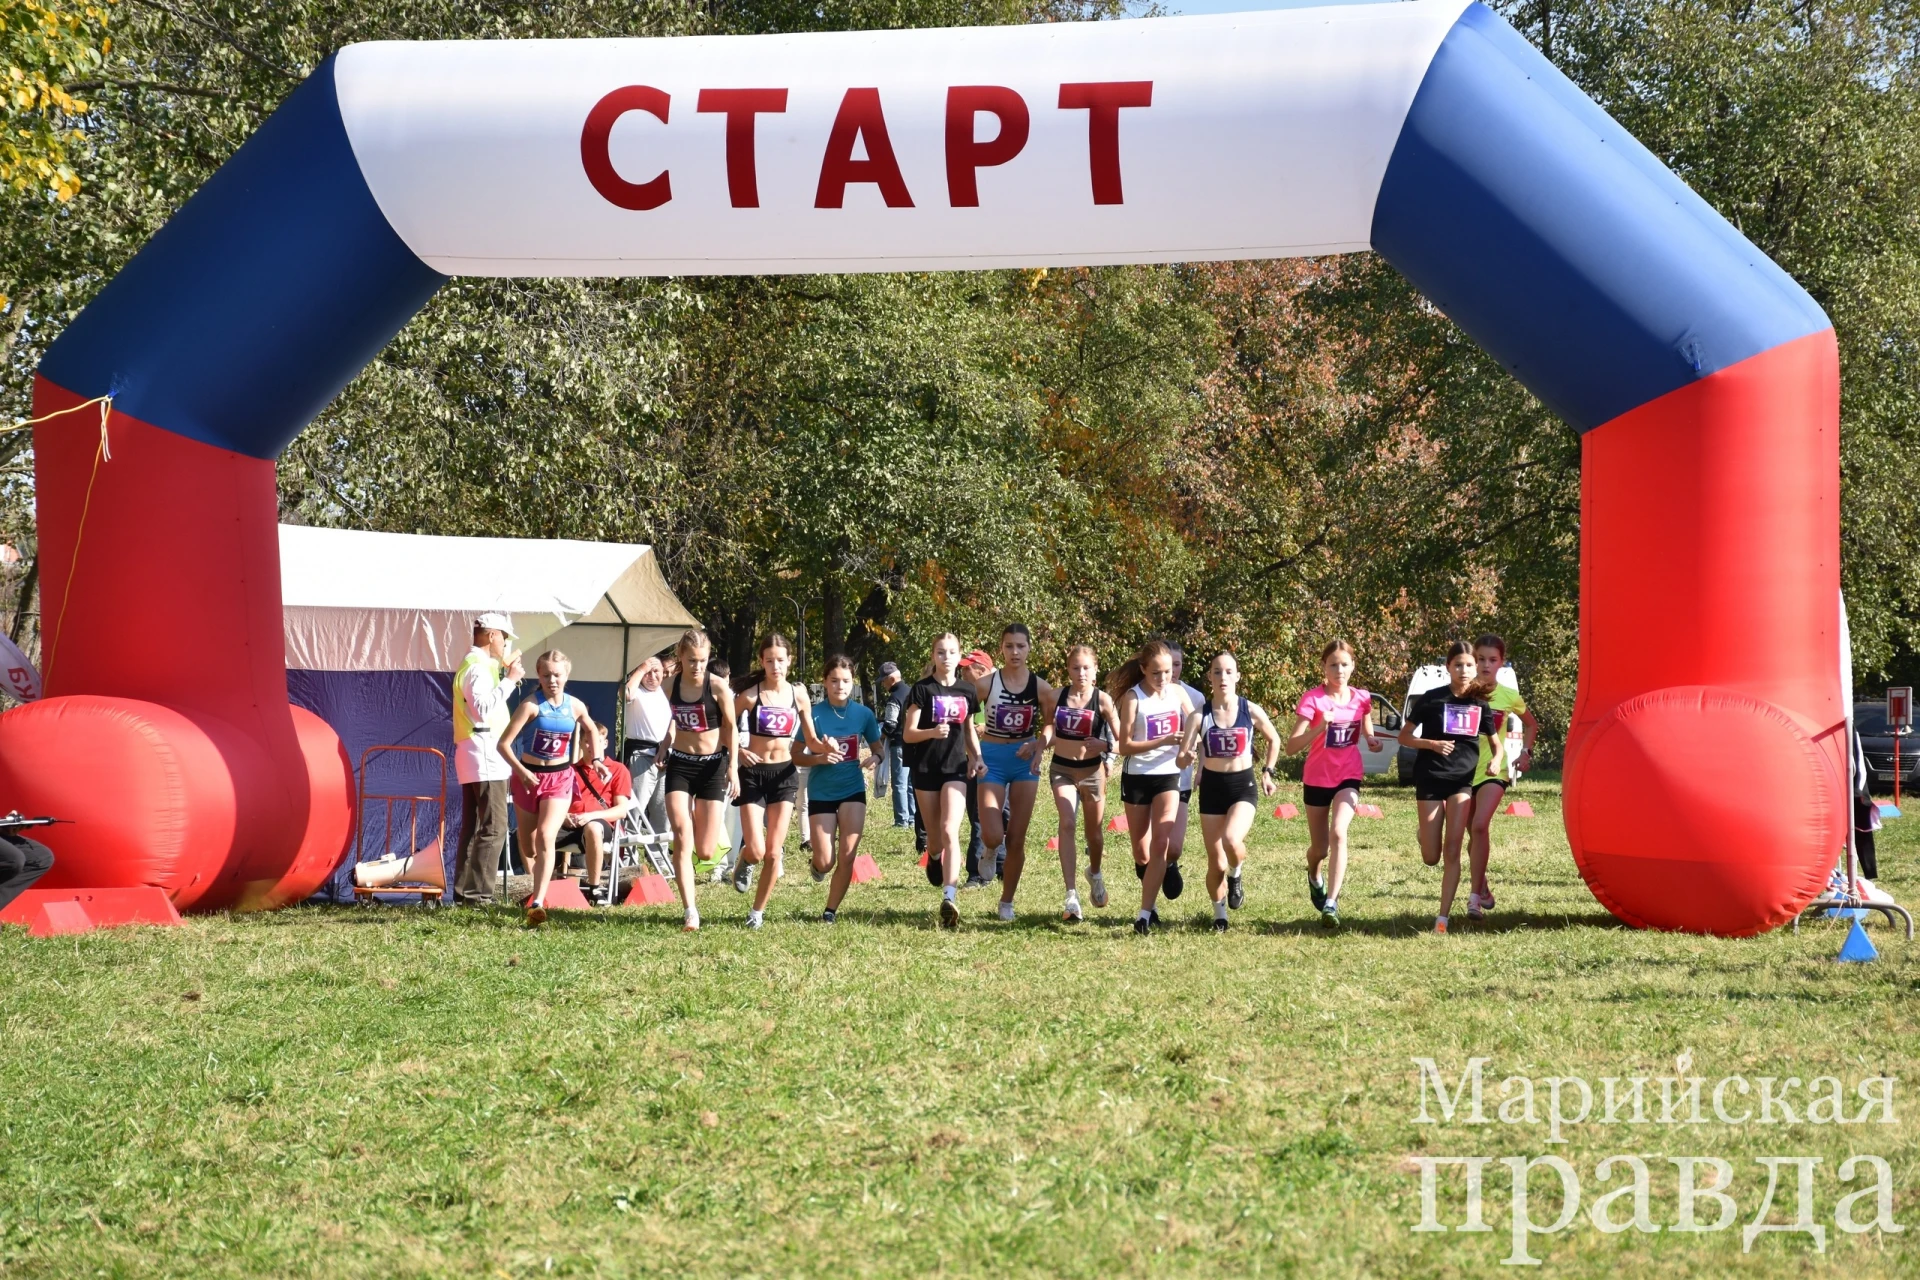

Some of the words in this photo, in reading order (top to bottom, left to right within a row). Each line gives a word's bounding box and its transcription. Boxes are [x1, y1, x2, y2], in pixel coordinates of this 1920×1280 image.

[580, 80, 1154, 211] СТАРТ
[943, 703, 960, 717] 18
[676, 713, 699, 726] 118
[766, 714, 788, 729] 29
[1003, 712, 1024, 727] 68
[1065, 715, 1083, 730] 17
[1155, 719, 1172, 734] 15
[1456, 713, 1471, 728] 11
[1334, 727, 1356, 743] 117
[542, 737, 562, 752] 79
[1218, 736, 1237, 751] 13
[670, 749, 699, 762] NIKE
[699, 753, 723, 762] PRO
